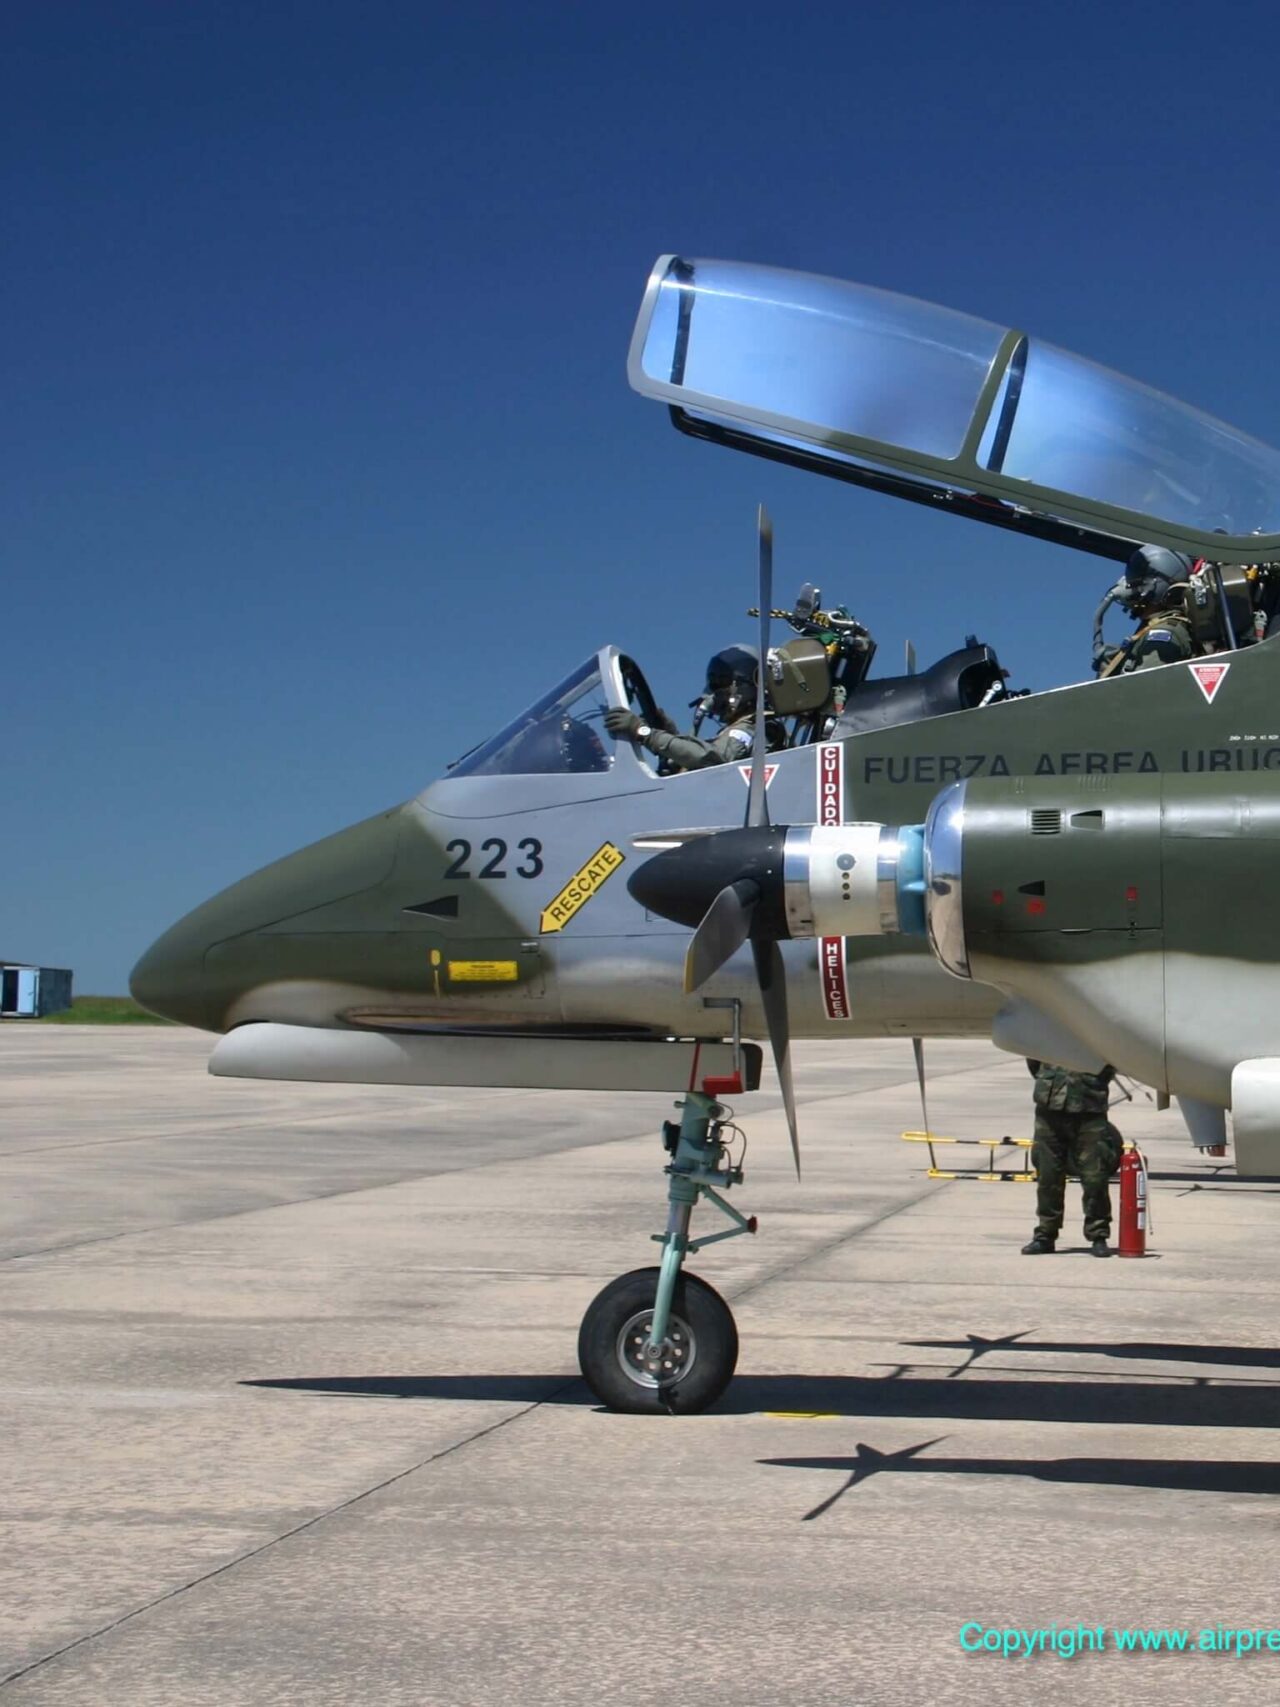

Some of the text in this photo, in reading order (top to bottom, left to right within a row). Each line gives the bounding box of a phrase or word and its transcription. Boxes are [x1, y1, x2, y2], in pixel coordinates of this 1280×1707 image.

[864, 754, 1011, 784] FUERZA
[1034, 752, 1159, 775] AEREA
[443, 837, 544, 879] 223
[550, 850, 617, 922] RESCATE
[826, 943, 844, 1018] HELICES
